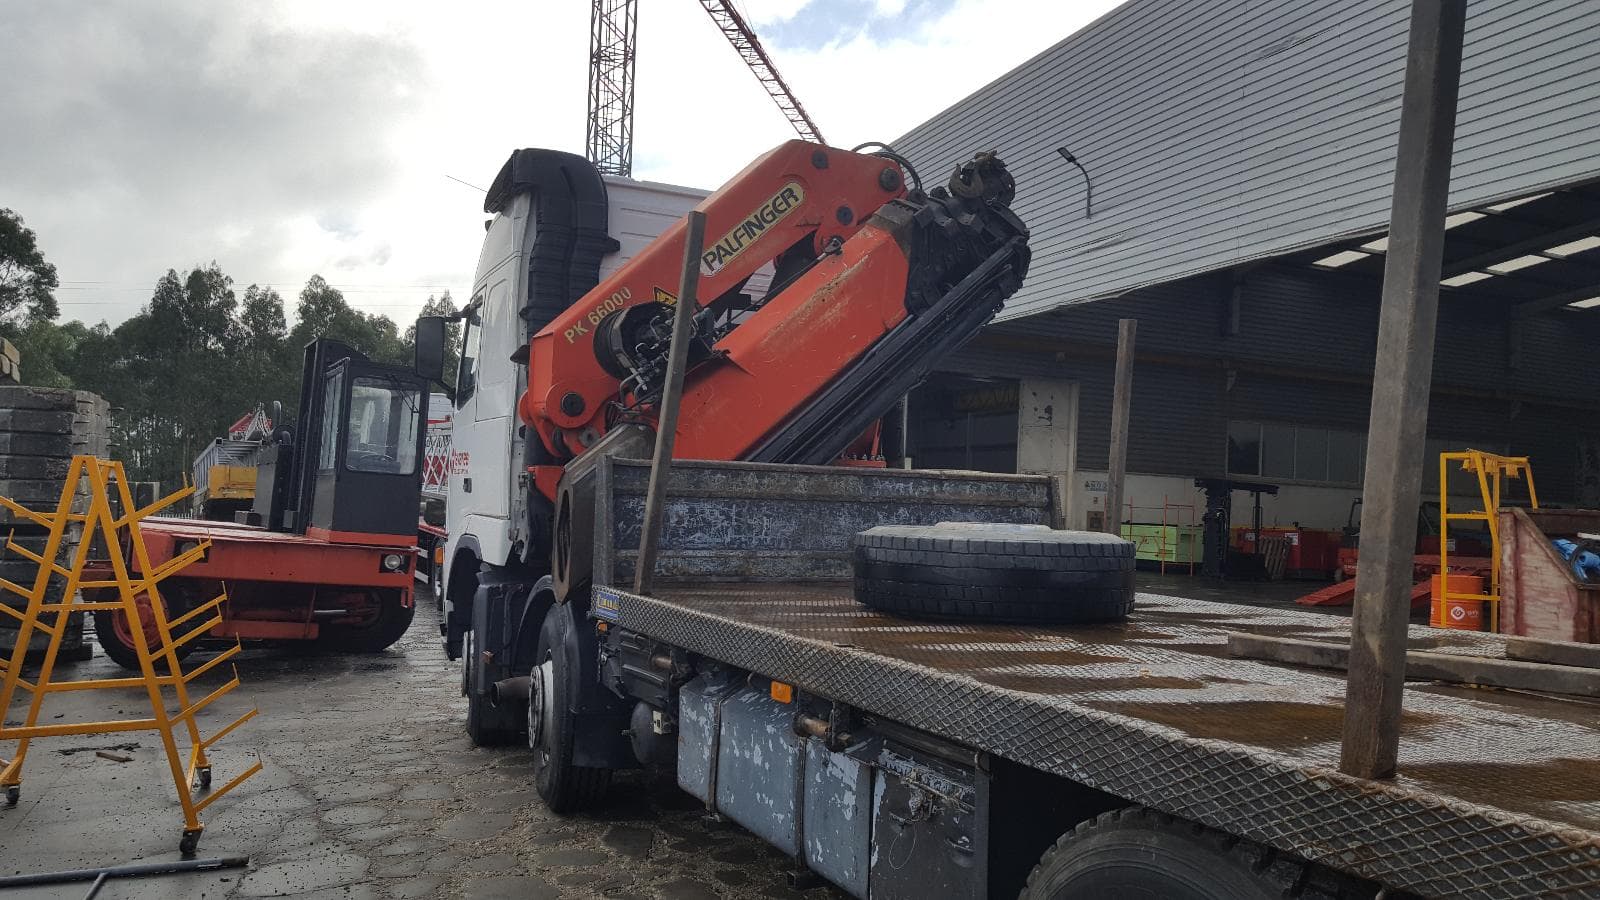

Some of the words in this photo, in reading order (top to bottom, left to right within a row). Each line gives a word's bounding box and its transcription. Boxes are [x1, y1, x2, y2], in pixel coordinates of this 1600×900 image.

[702, 187, 800, 272] PALFINGER
[564, 320, 588, 344] PK
[588, 286, 632, 326] 66000
